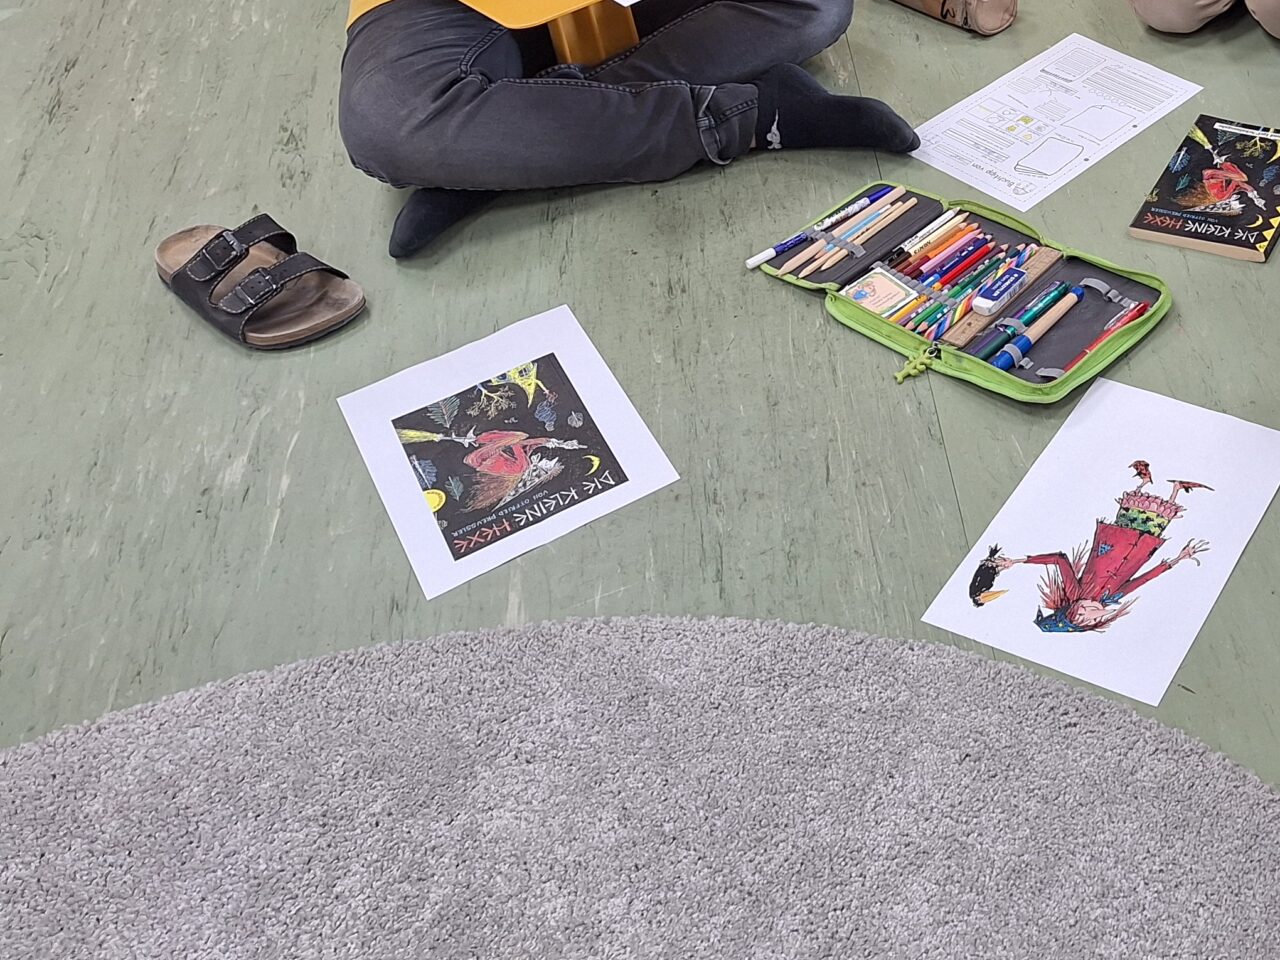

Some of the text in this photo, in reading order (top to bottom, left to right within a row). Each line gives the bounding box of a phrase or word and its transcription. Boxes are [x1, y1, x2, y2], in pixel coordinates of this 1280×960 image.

[1143, 212, 1260, 244] DIE KLEINE HEXE
[453, 470, 616, 553] DIE KLEINE HEXE
